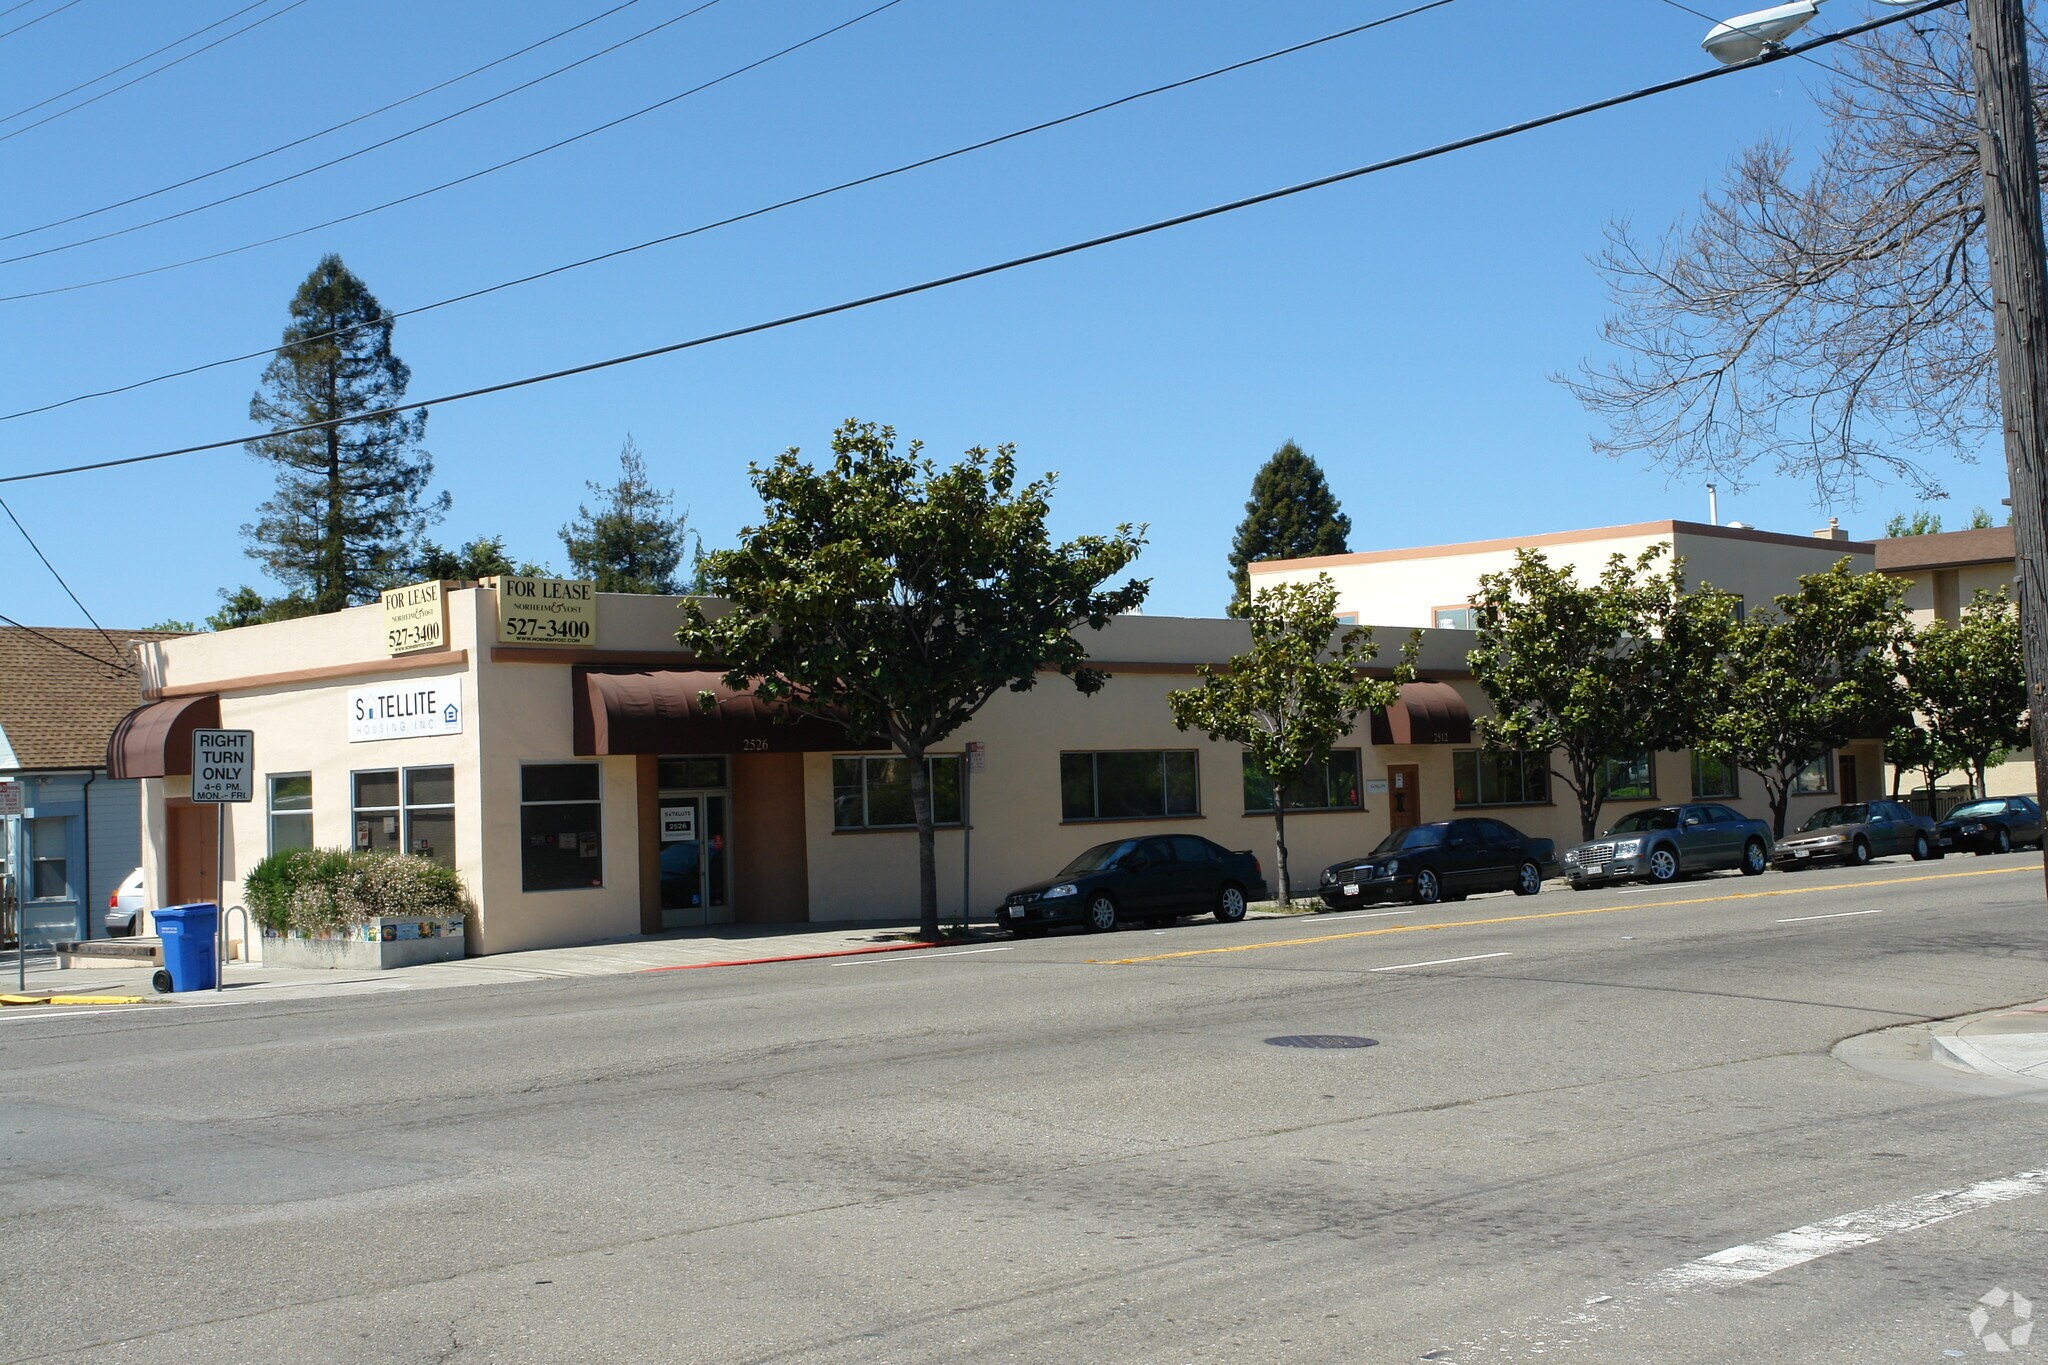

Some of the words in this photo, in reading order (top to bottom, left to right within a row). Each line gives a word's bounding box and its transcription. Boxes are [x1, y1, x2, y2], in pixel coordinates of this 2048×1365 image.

[506, 580, 536, 597] FOR
[543, 582, 591, 600] LEASE
[386, 592, 404, 610] FOR
[408, 585, 437, 606] LEASE
[513, 602, 552, 611] NORHEIM
[389, 622, 439, 647] 527-3400
[506, 618, 590, 638] 527-3400
[356, 721, 406, 735] HOUSING
[414, 718, 435, 731] INC
[200, 734, 247, 747] RIGHT
[1433, 733, 1448, 742] 2512
[743, 738, 769, 751] 2526
[202, 751, 244, 763] TURN
[203, 767, 241, 780] ONLY
[204, 783, 222, 791] 4-6
[226, 783, 242, 791] PM.
[231, 791, 248, 799] FRI.
